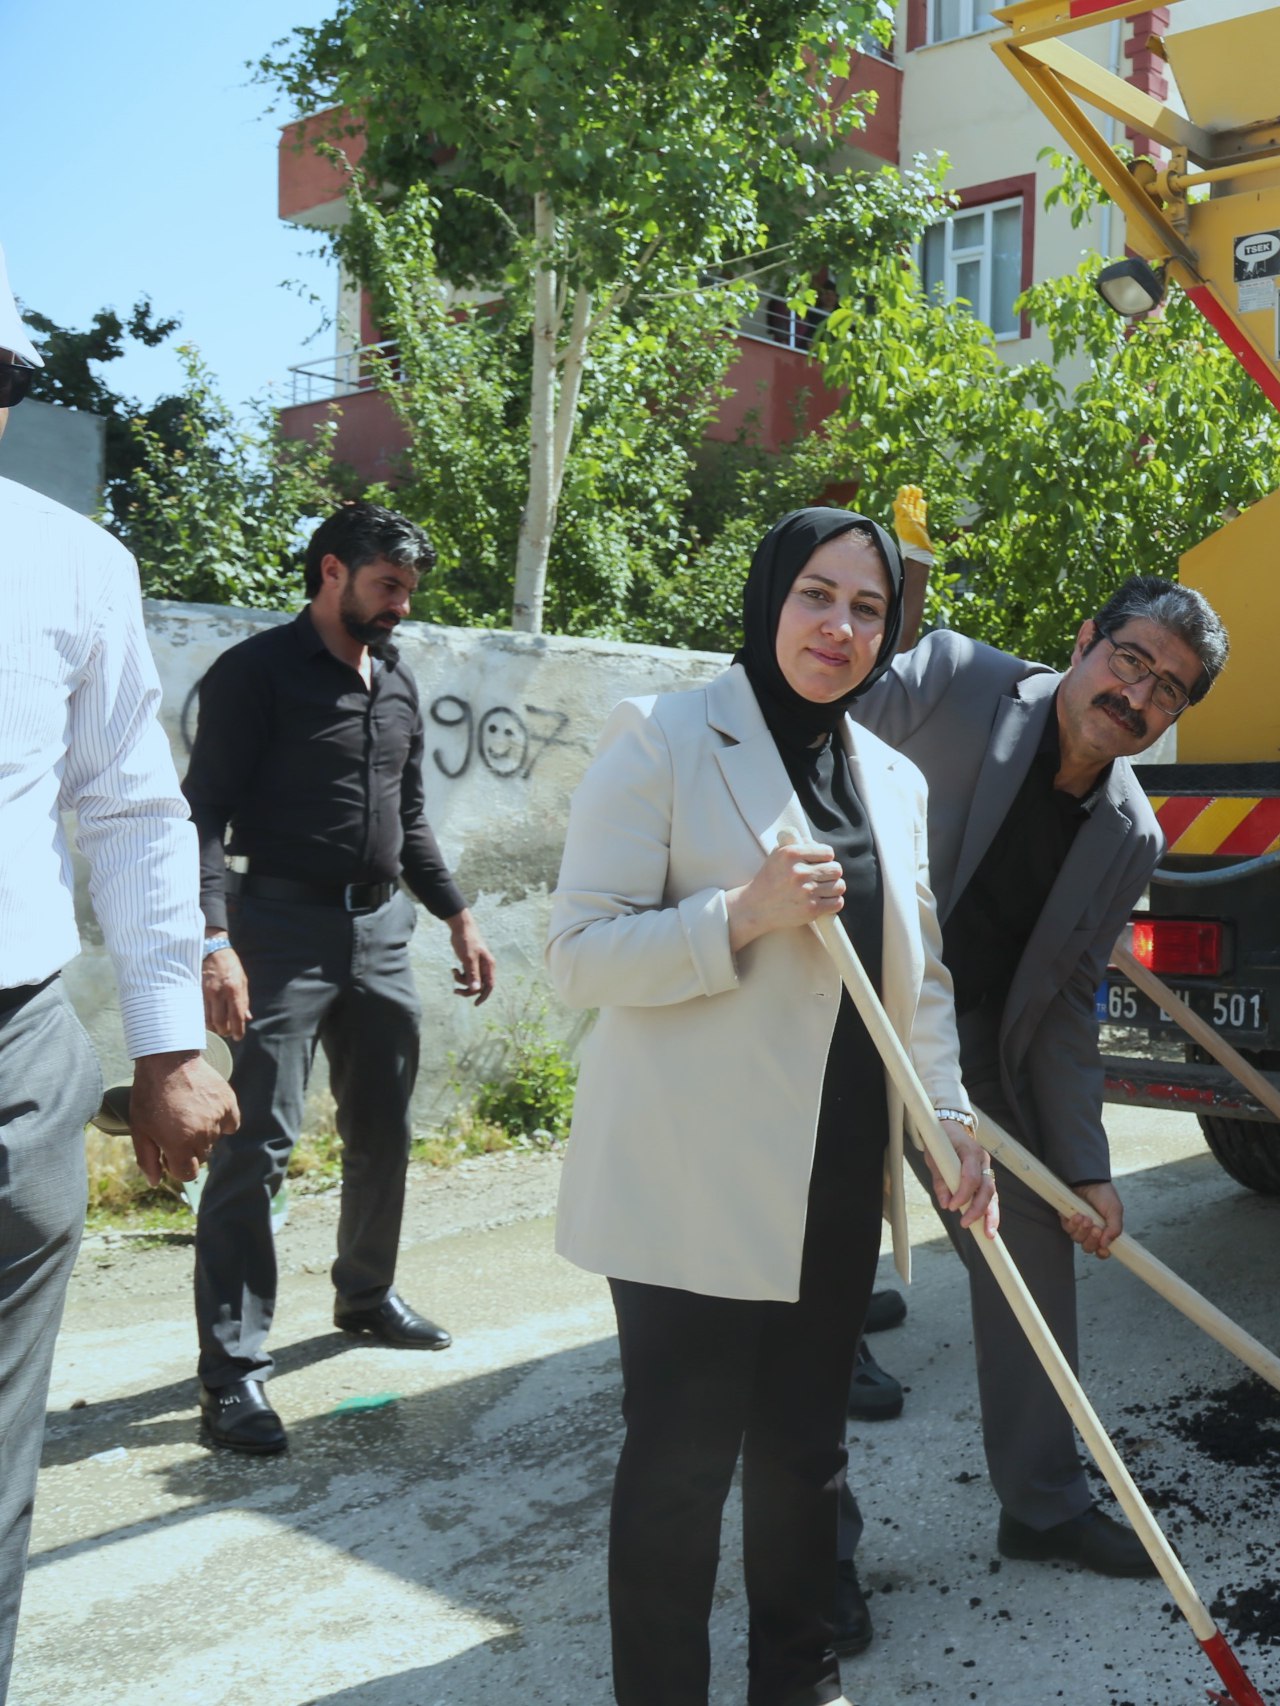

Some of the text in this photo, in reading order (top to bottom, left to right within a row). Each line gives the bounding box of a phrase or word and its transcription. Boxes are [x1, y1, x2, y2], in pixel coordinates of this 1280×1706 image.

[1245, 241, 1271, 255] TSEK
[1096, 1002, 1107, 1012] TR
[1108, 986, 1138, 1019] 65
[1213, 992, 1260, 1028] 501
